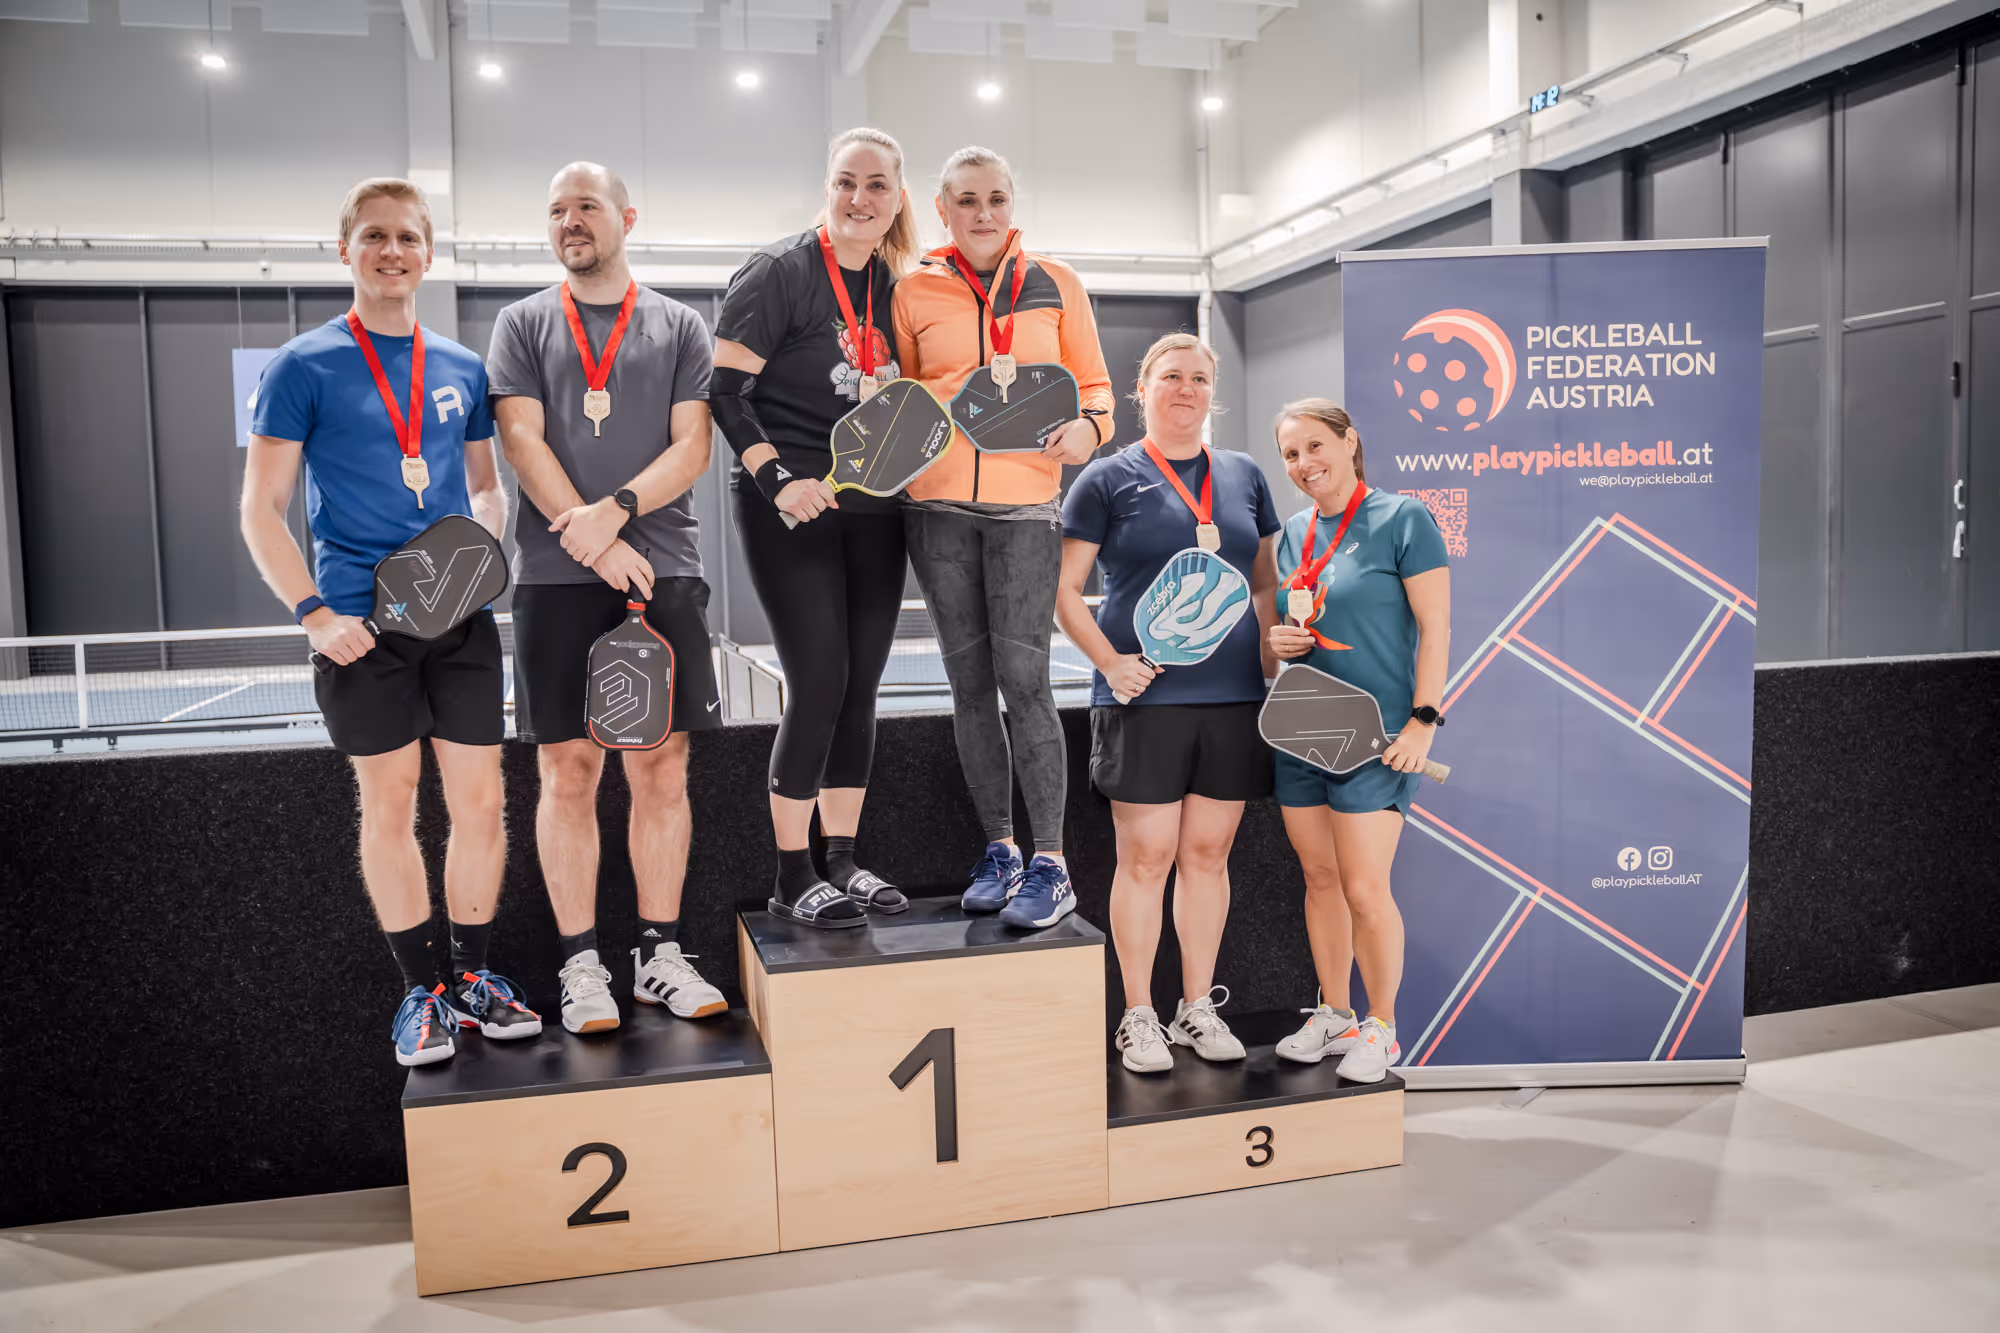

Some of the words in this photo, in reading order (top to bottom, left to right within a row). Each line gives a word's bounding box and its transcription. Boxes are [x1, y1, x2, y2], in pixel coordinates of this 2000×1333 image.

[1526, 322, 1702, 349] PICKLEBALL
[1527, 352, 1716, 379] FEDERATION
[1526, 384, 1654, 409] AUSTRIA
[925, 427, 944, 459] JOOLA
[1395, 440, 1713, 476] www.playpickleball.at
[1579, 472, 1714, 488] we@playpickleball.at
[1591, 873, 1703, 889] @playpickleballAT
[889, 1027, 958, 1164] 1
[1245, 1125, 1274, 1169] 3
[562, 1142, 630, 1229] 2
